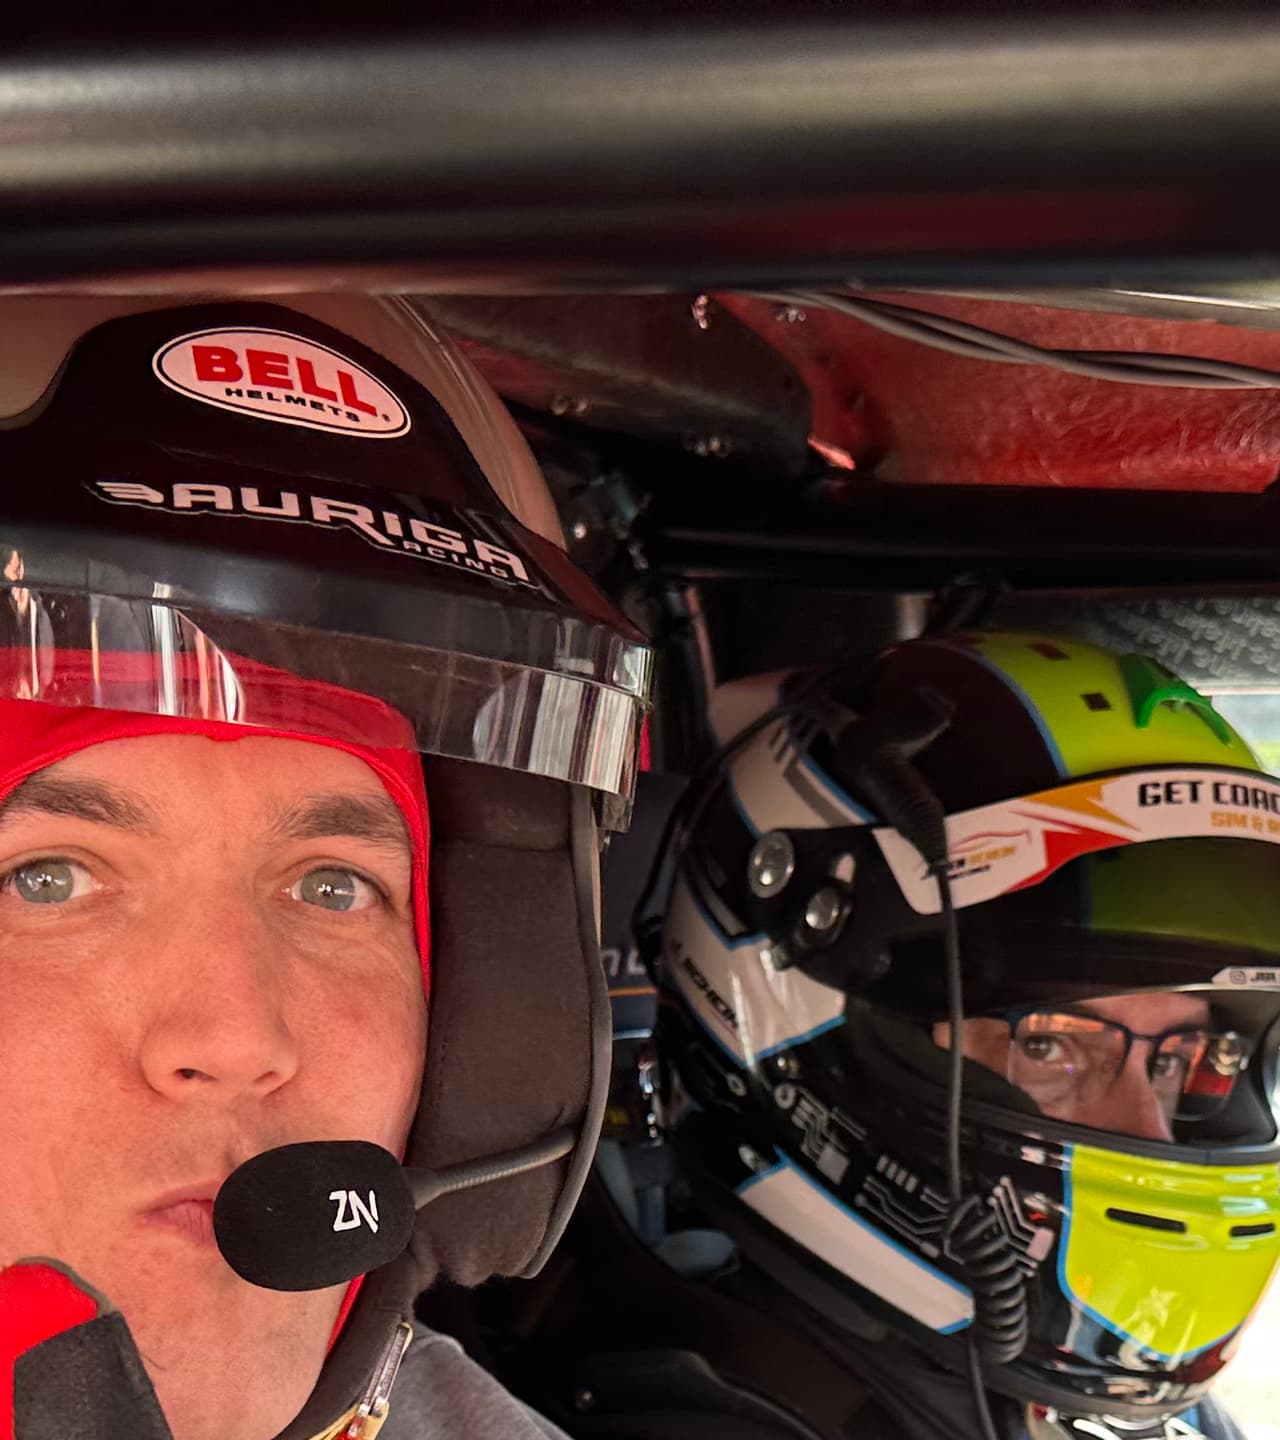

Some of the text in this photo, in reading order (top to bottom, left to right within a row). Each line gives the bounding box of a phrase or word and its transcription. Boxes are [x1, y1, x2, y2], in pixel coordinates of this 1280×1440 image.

[192, 345, 378, 418] BELL
[225, 387, 361, 424] HELMETS
[1138, 780, 1203, 807] GET
[1210, 811, 1248, 829] SIM
